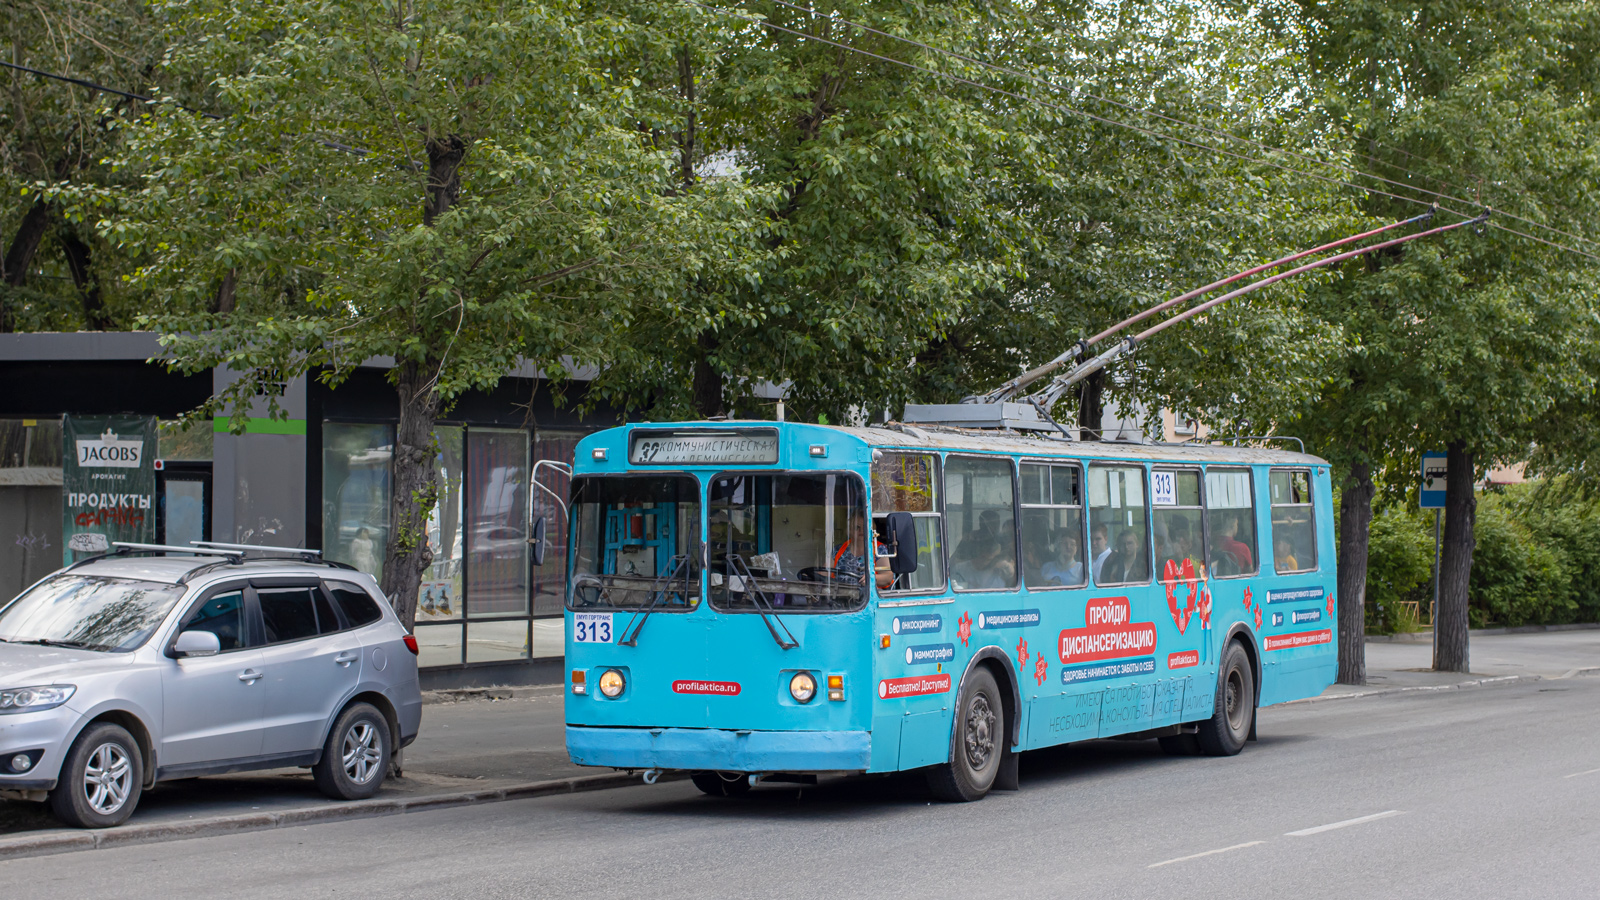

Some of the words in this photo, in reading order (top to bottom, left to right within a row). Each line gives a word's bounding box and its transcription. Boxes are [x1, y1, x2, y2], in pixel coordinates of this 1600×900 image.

[81, 446, 138, 463] JACOBS
[639, 441, 660, 462] 32
[660, 440, 776, 452] КОММУНИСТИЧЕСКАЯ
[1156, 474, 1171, 494] 313
[68, 493, 151, 509] ПРОДУКТЫ
[986, 614, 1019, 626] медицинские
[1020, 613, 1039, 623] анализы
[1089, 601, 1127, 625] ПРОЙДИ
[576, 621, 611, 642] 313
[901, 619, 940, 631] онкоскрининг
[1062, 629, 1154, 659] ДИСПАНСЕРИЗАЦИЮ
[914, 647, 953, 660] маммография
[1170, 654, 1196, 668] profilaktica.ru
[1063, 668, 1087, 682] ЗДОРОВЬЕ
[1088, 665, 1116, 679] НАЧИНАЕТСЯ
[1117, 664, 1121, 674] С
[1121, 662, 1139, 674] ЗАБОТЫ
[1139, 662, 1144, 672] О
[1144, 660, 1154, 672] СЕБЕ
[677, 682, 737, 692] profilaktica.ru
[888, 680, 920, 694] Бесплатно!
[921, 678, 948, 692] Доступно!
[1075, 690, 1115, 708] ИМЕЮТСЯ
